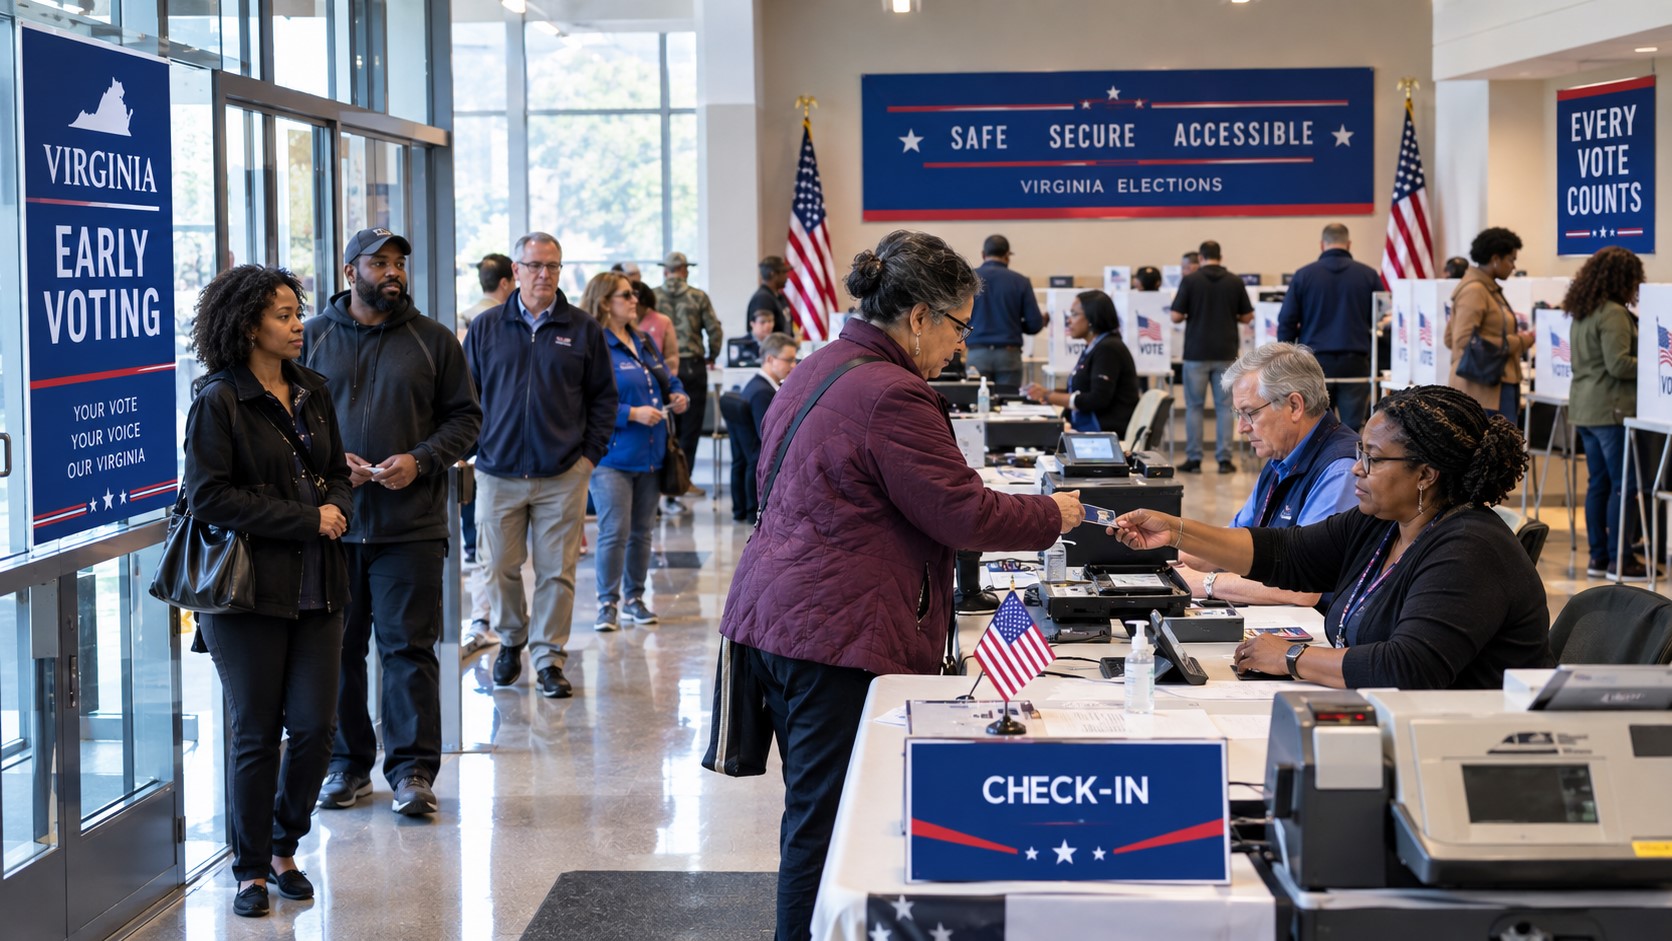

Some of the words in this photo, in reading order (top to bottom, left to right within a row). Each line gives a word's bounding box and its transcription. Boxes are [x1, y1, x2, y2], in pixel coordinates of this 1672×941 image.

[951, 125, 1008, 150] SAFE
[1049, 123, 1135, 148] SECURE
[1174, 121, 1313, 147] ACCESSIBLE
[1571, 104, 1637, 142] EVERY
[43, 143, 158, 193] VIRGINIA
[1577, 144, 1630, 178] VOTE
[1021, 179, 1104, 194] VIRGINIA
[1118, 177, 1222, 193] ELECTIONS
[1567, 181, 1642, 216] COUNTS
[55, 224, 149, 278] EARLY
[43, 287, 161, 345] VOTING
[1140, 343, 1164, 355] VOTE
[1661, 375, 1672, 395] VO
[73, 402, 105, 422] YOUR
[109, 396, 137, 415] VOTE
[71, 429, 103, 450] YOUR
[107, 422, 141, 442] VOICE
[67, 458, 92, 479] OUR
[96, 447, 145, 472] VIRGINIA
[982, 775, 1149, 804] CHECK-IN
